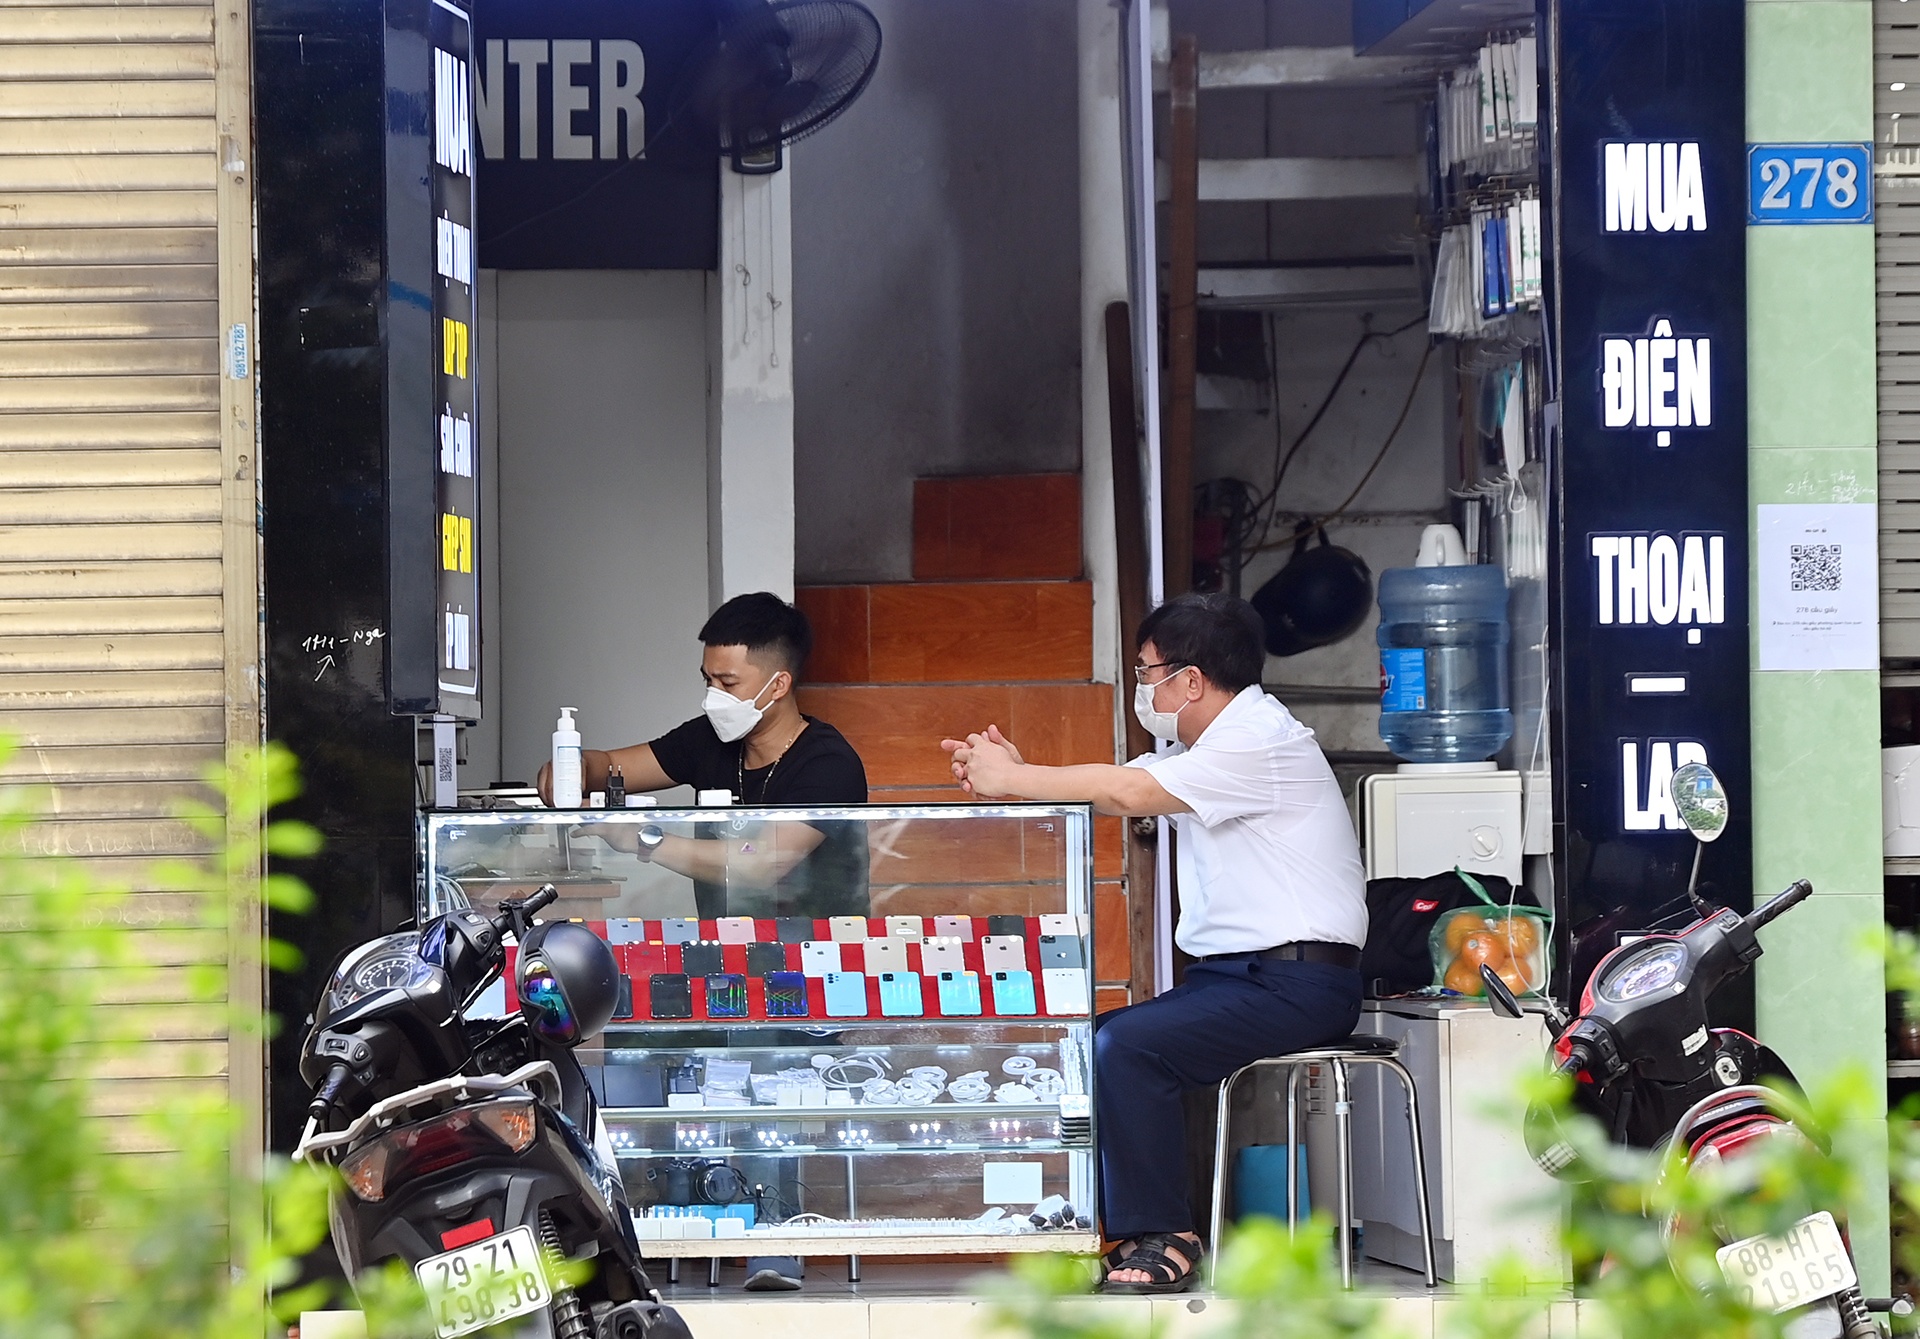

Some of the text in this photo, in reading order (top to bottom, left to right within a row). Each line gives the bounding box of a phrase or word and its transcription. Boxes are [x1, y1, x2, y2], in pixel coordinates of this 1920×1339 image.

[434, 46, 471, 177] MUA
[1604, 142, 1708, 233] MUA
[1759, 158, 1859, 211] 278
[1602, 319, 1712, 448] ĐIỆN
[1591, 535, 1726, 645] THOẠI
[436, 1238, 519, 1294] 29-Z1
[1738, 1224, 1820, 1278] 88-H1
[439, 1271, 542, 1331] 498.38
